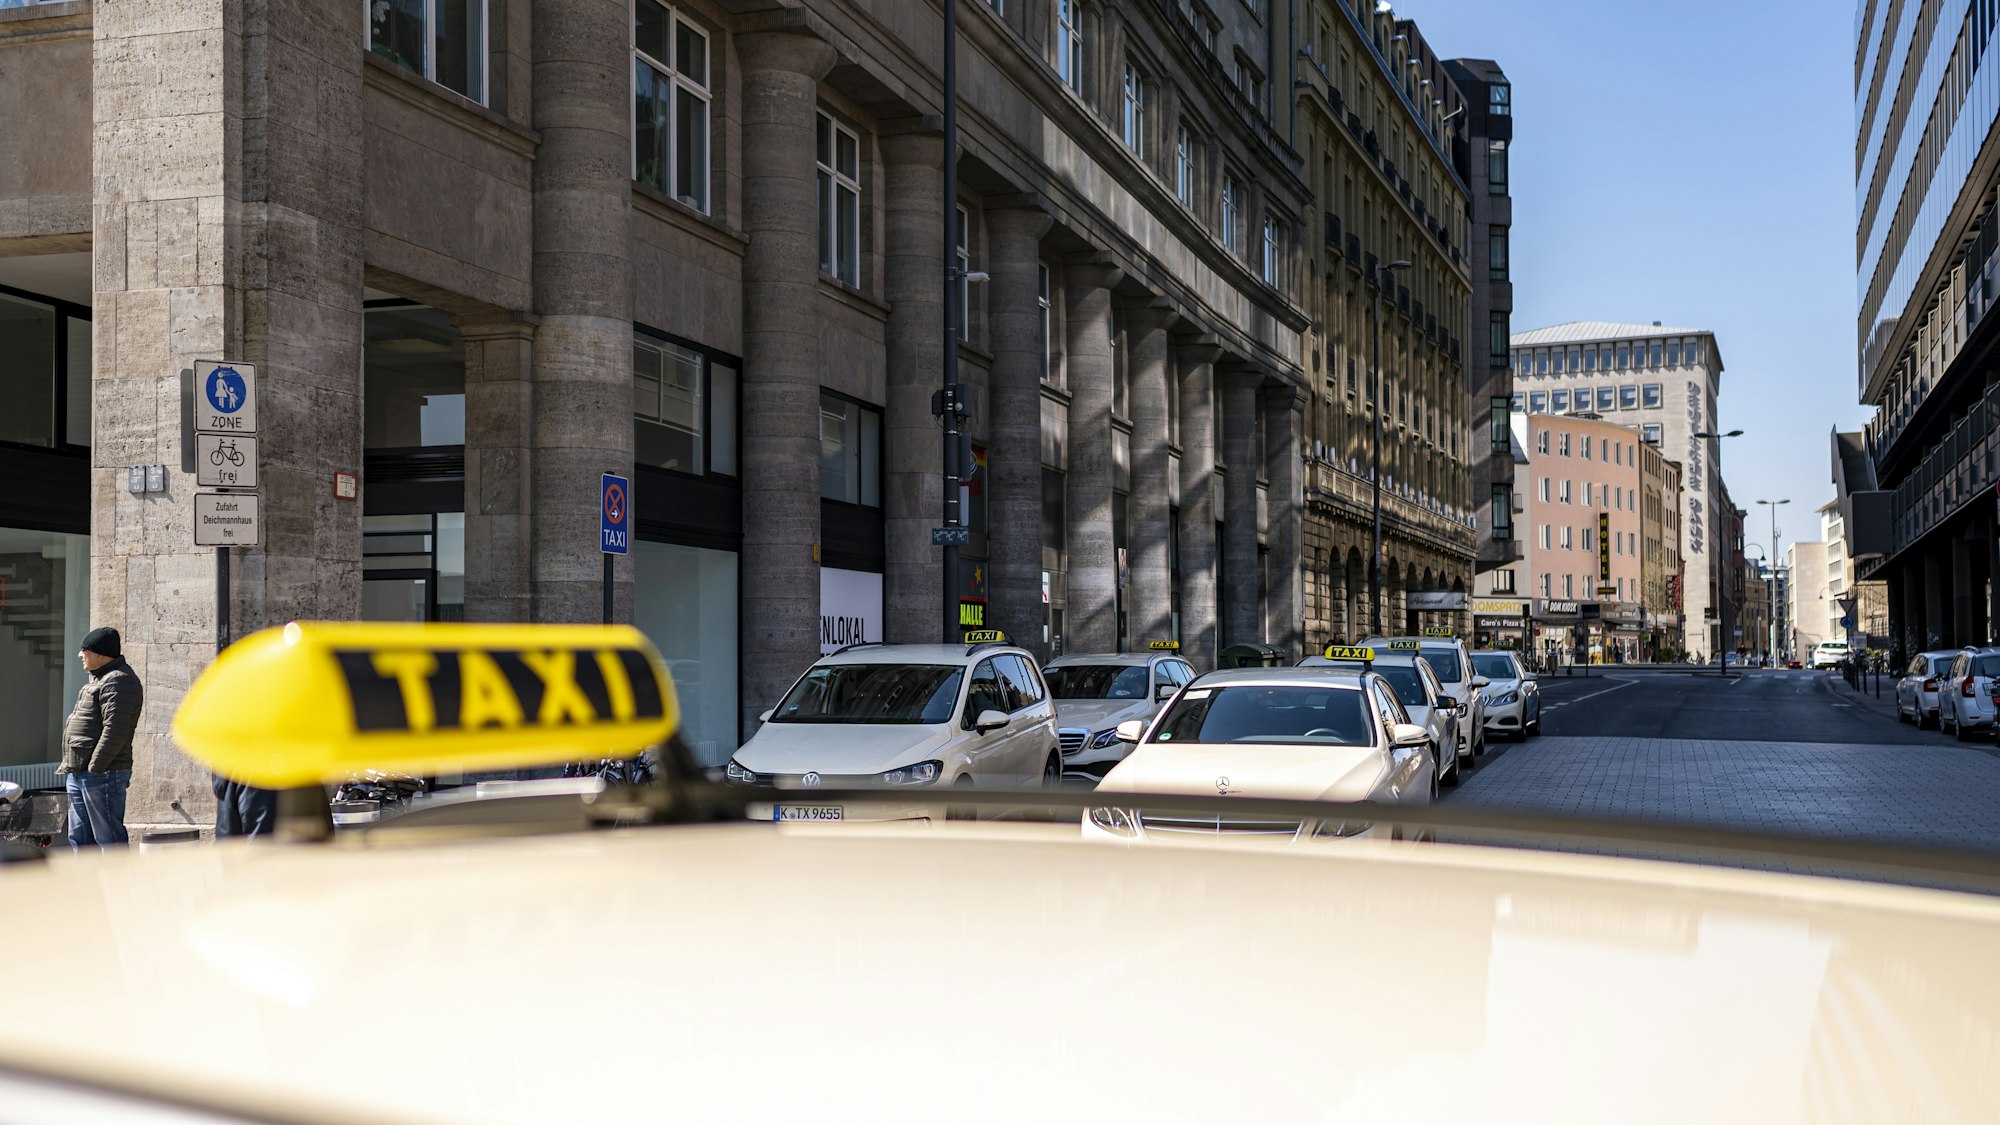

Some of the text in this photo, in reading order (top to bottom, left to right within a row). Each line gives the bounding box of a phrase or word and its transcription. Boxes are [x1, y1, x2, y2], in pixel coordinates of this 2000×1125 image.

[211, 416, 242, 429] ZONE
[218, 470, 237, 481] frei
[215, 502, 238, 512] Zufahrt
[203, 515, 252, 525] Deichmannhaus
[223, 529, 234, 538] frei
[603, 528, 626, 548] TAXI
[1550, 602, 1577, 613] DOM KIOSK
[960, 604, 984, 626] HALLE
[1502, 619, 1519, 627] Pizza
[970, 631, 995, 641] TAXI
[1391, 641, 1415, 649] TAXI
[1334, 649, 1367, 658] TAXI
[370, 650, 636, 733] TAXI
[780, 807, 840, 820] K TX 9655
